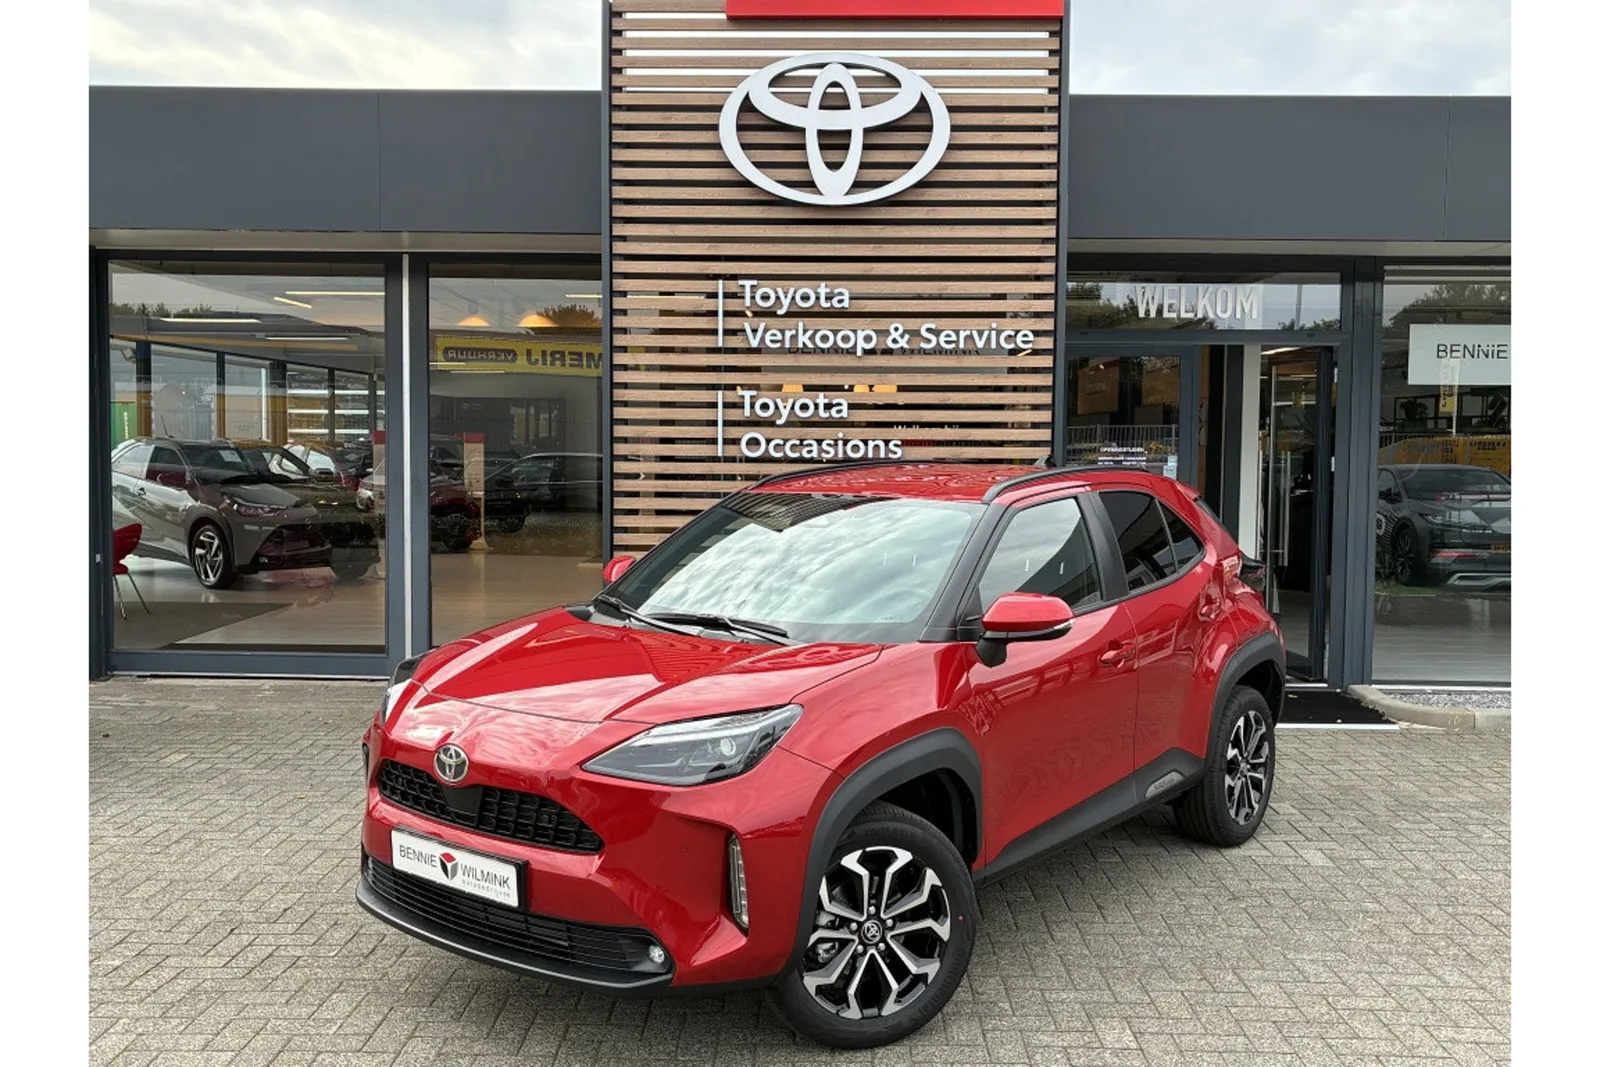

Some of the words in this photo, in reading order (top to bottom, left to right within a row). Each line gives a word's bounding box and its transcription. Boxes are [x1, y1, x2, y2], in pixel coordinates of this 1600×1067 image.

[738, 280, 850, 315] Toyota
[1135, 286, 1258, 319] WELKOM
[744, 321, 877, 356] Verkoop
[886, 323, 910, 349] &
[919, 322, 1034, 349] Service
[1436, 344, 1508, 359] BENNIE
[738, 390, 849, 425] Toyota
[740, 432, 903, 458] Occasions
[399, 844, 438, 868] BENNIE
[460, 863, 511, 890] WILMINK
